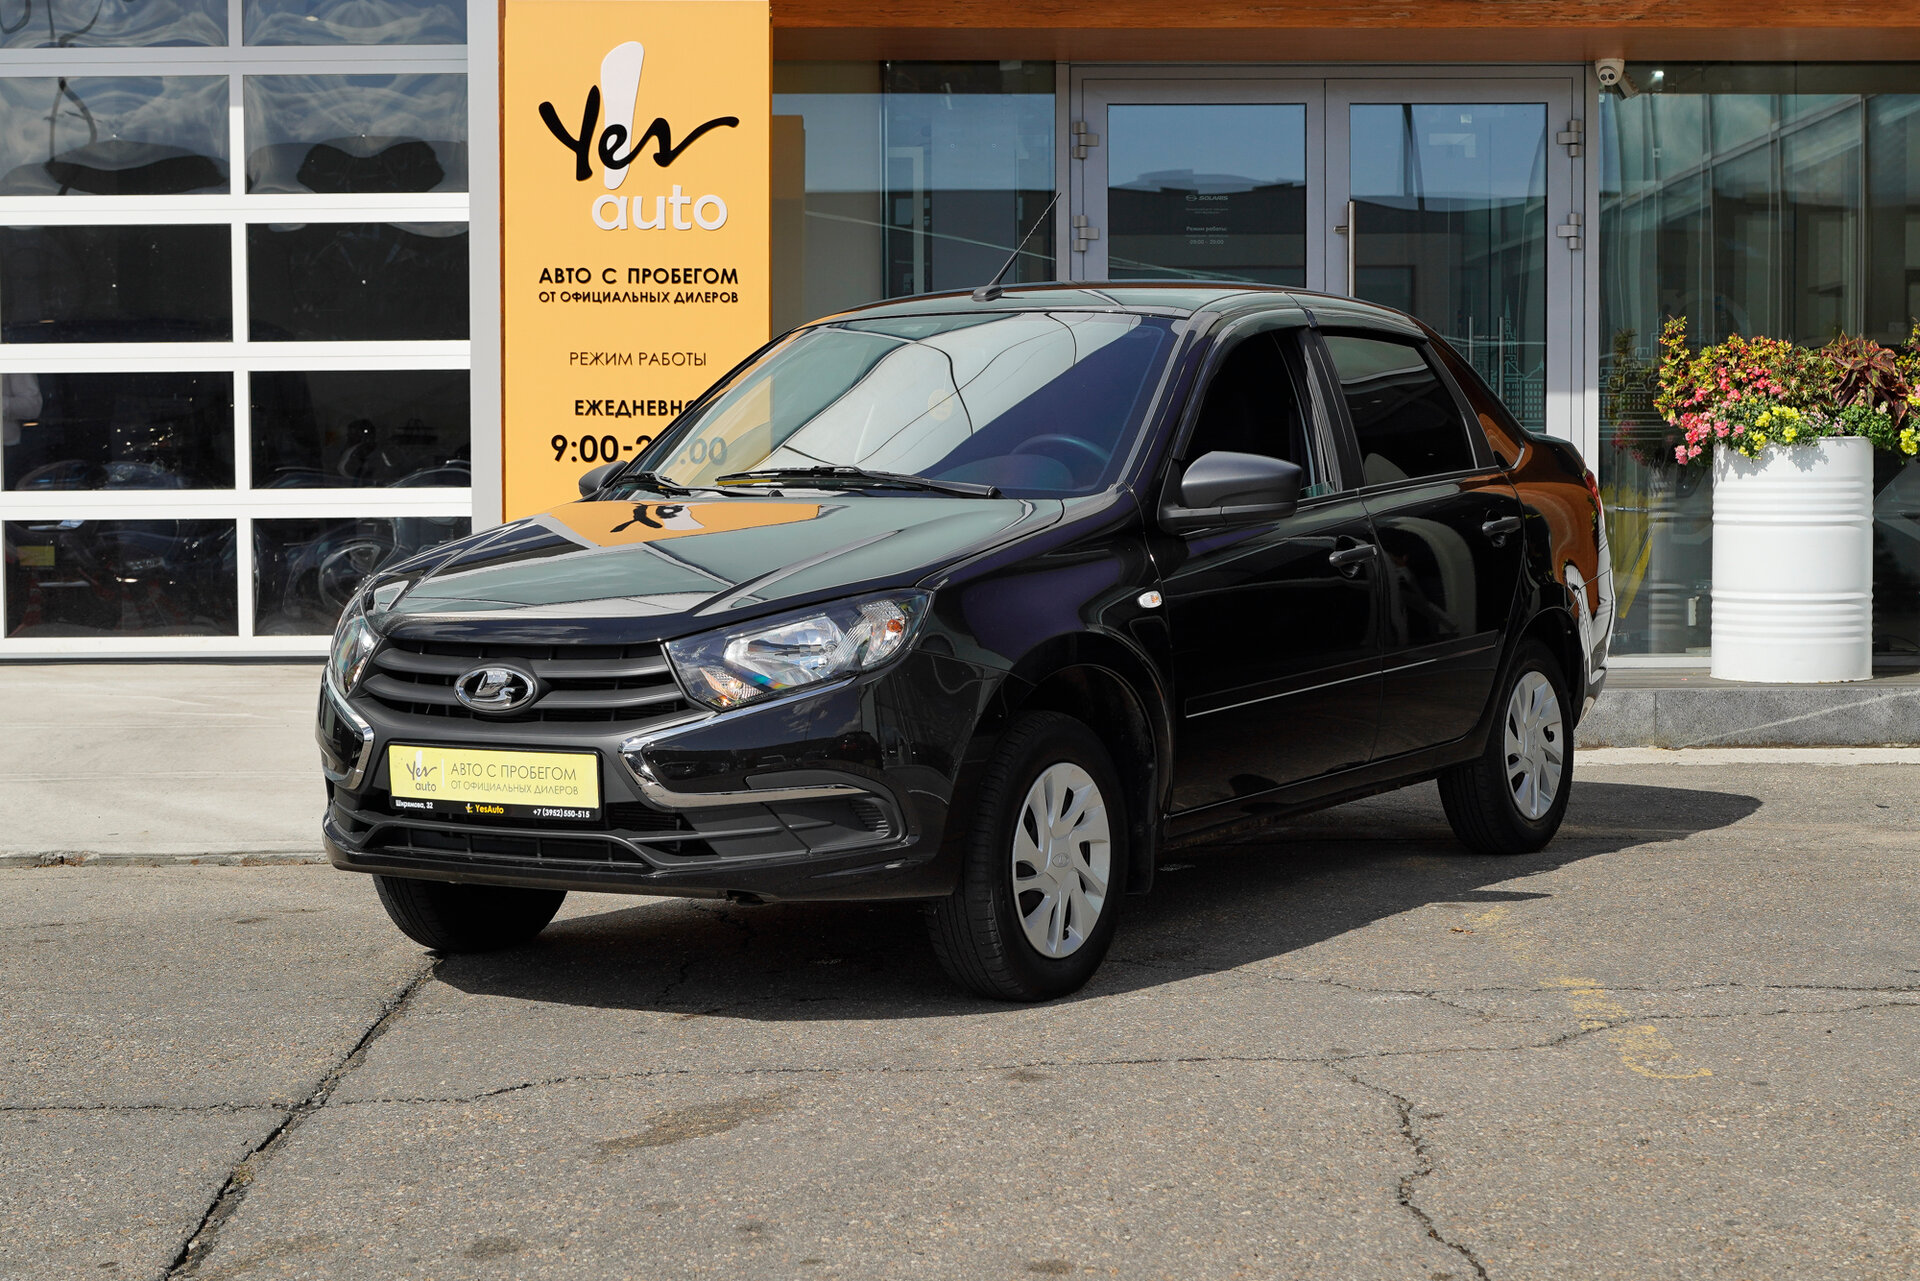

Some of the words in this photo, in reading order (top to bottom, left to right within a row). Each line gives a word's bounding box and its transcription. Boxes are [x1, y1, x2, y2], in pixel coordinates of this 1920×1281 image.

[591, 184, 729, 231] auto
[539, 267, 592, 284] АВТО
[602, 267, 617, 284] С
[627, 267, 739, 285] ПРОБЕГОМ
[538, 291, 556, 303] ОТ
[560, 291, 670, 304] ОФИЦИАЛЬНЫХ
[673, 291, 739, 304] ДИЛЕРОВ
[569, 352, 633, 366] РЕЖИМ
[638, 352, 707, 366] РАБОТЫ
[450, 763, 483, 777] АВТО
[486, 765, 496, 778] С
[500, 764, 577, 781] ПРОБЕГОМ
[415, 781, 437, 792] auto
[450, 780, 461, 790] ОТ
[464, 781, 532, 794] ОФИЦИАЛЬНЫХ
[534, 785, 579, 796] ДИЛЕРОВ
[475, 804, 504, 814] YesAuto
[542, 808, 563, 818] (3952)
